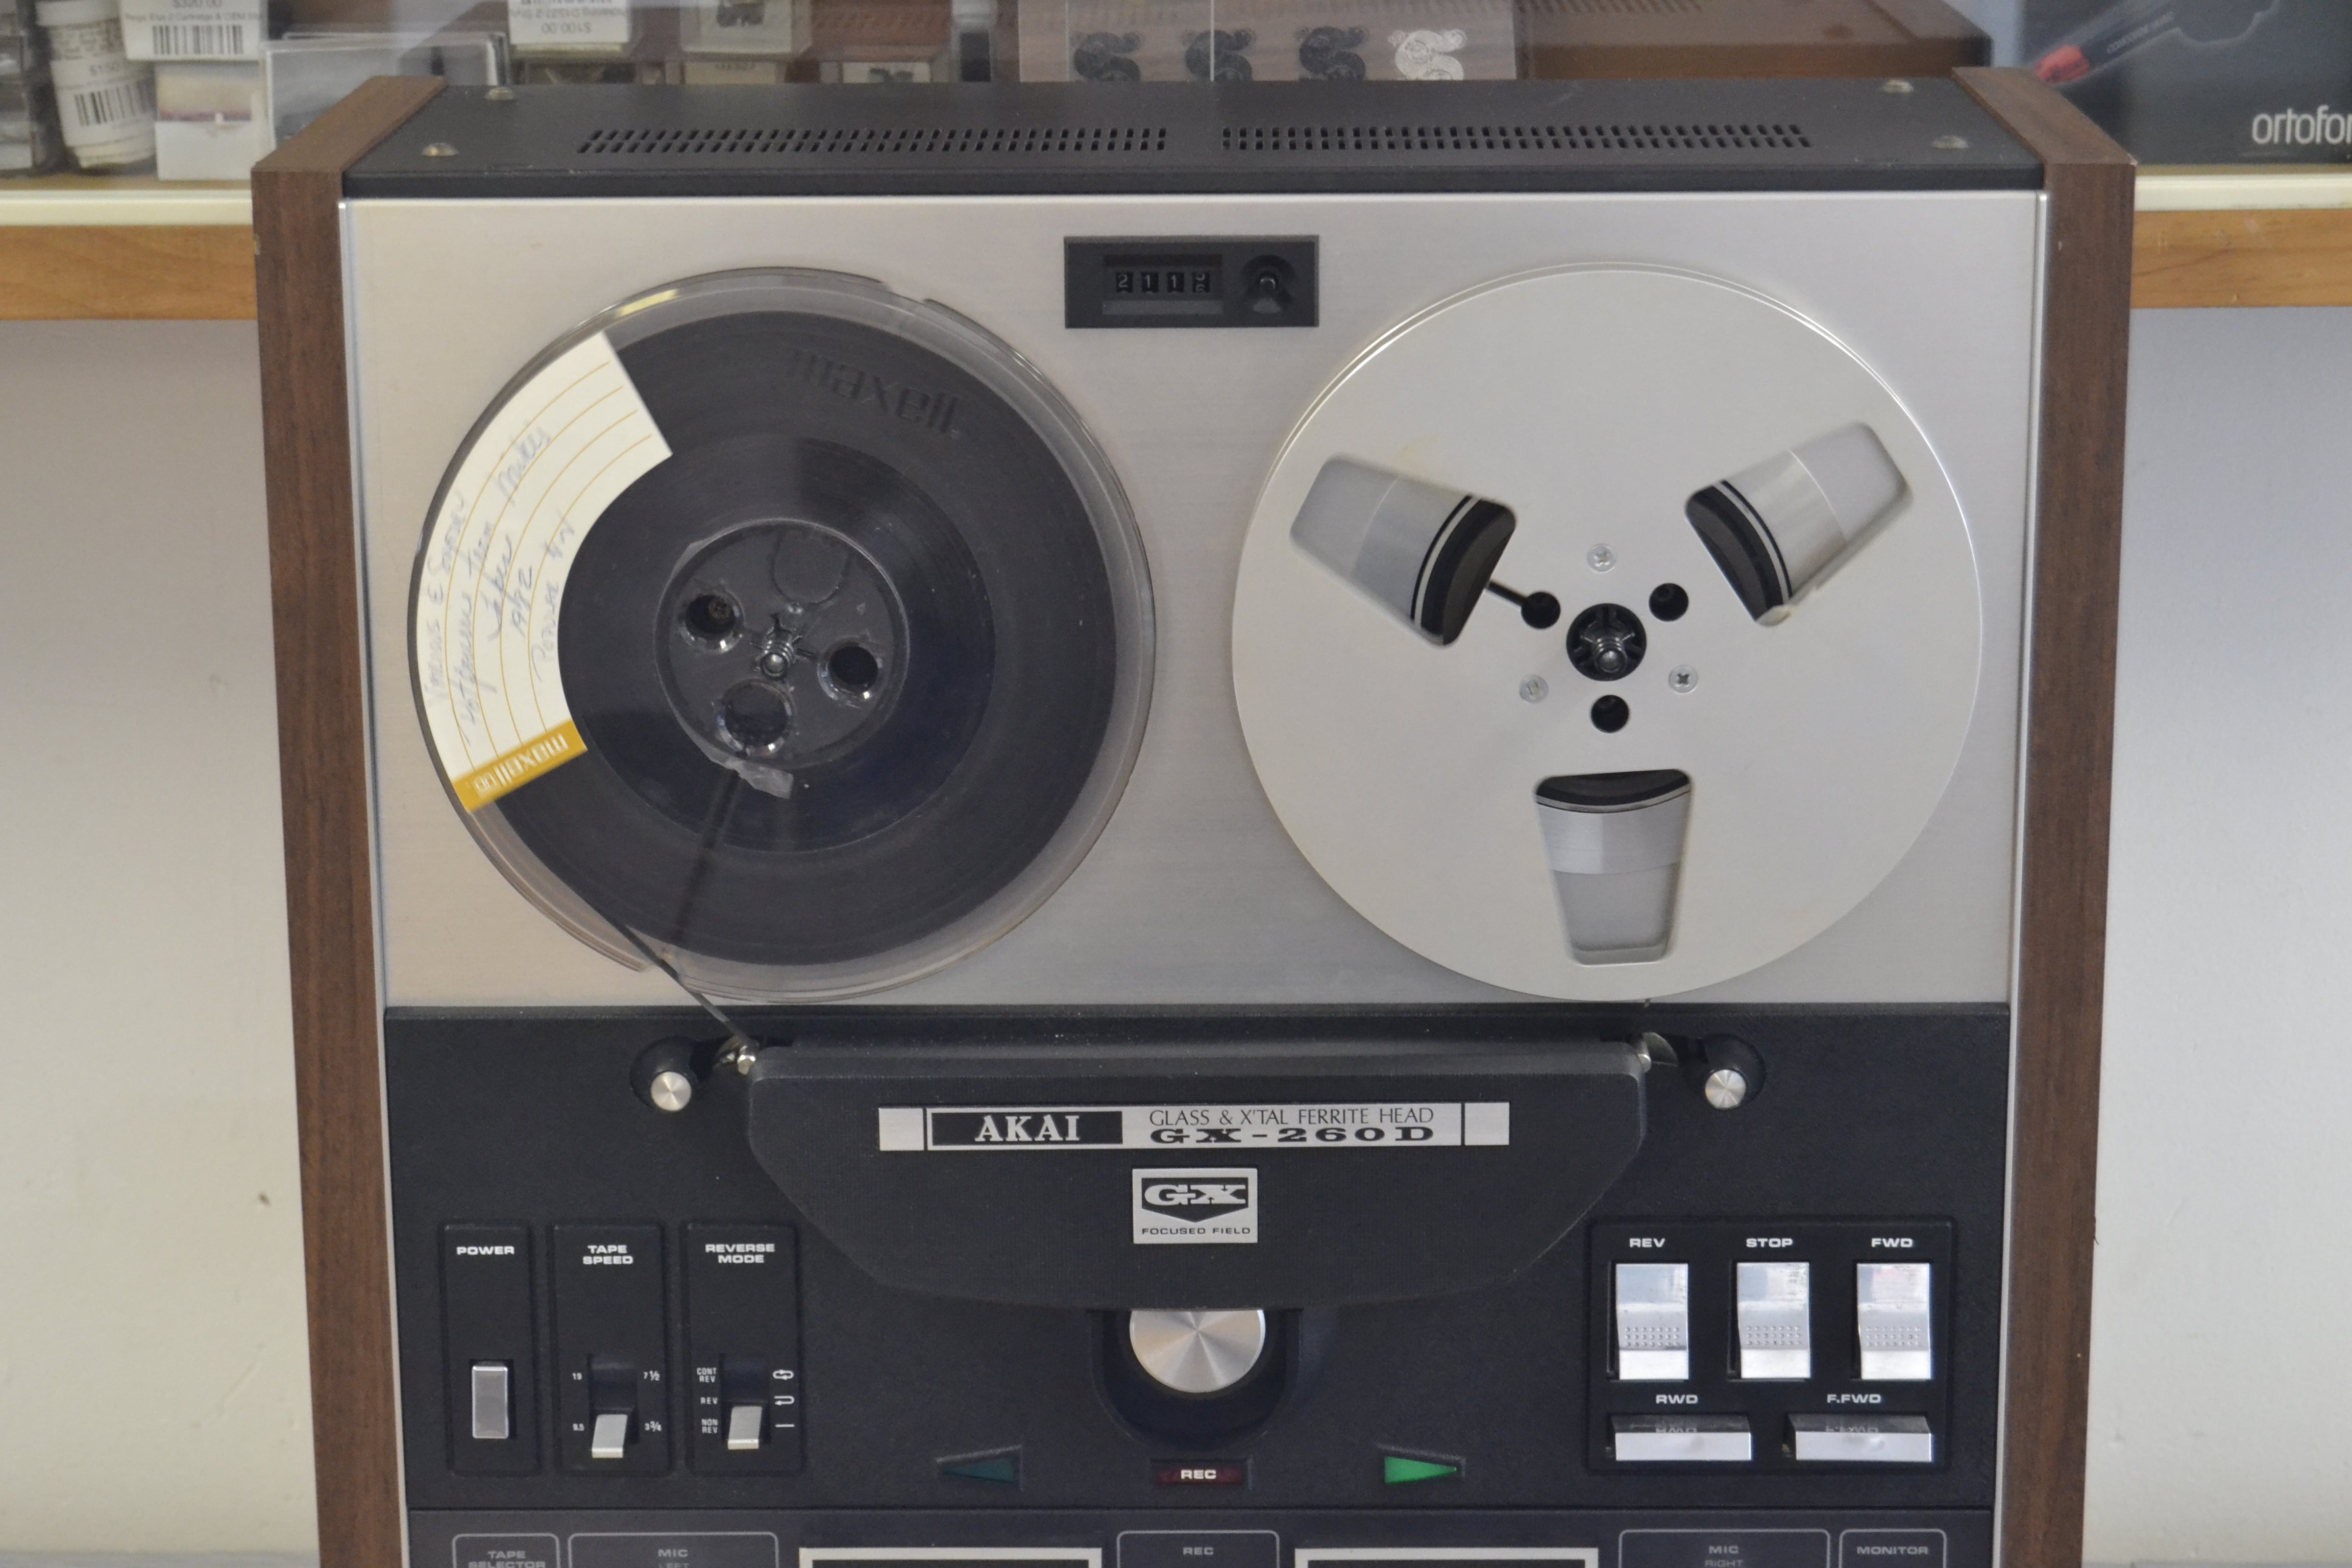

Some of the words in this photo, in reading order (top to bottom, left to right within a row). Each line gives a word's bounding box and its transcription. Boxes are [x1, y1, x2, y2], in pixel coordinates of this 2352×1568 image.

[1149, 1110, 1210, 1126] GLASS
[1219, 1110, 1233, 1125] &
[1240, 1109, 1289, 1125] X'TAL
[1298, 1108, 1369, 1124] FERRITE
[1379, 1108, 1434, 1123] HEAD
[975, 1115, 1080, 1142] AKAI
[1144, 1184, 1246, 1206] GX
[1141, 1227, 1206, 1235] FOCUSED
[1212, 1227, 1251, 1235] FIELD
[1629, 1237, 1666, 1248] REV
[1746, 1237, 1794, 1248] STOP
[1871, 1237, 1914, 1248] FWD
[456, 1245, 515, 1256] POWER
[587, 1244, 628, 1254] TAPE
[704, 1243, 776, 1253] REVERSE
[582, 1255, 634, 1265] SPEED
[717, 1254, 765, 1264] MODE
[696, 1366, 717, 1376] CONT
[698, 1375, 716, 1383] REV
[700, 1396, 719, 1405] REV
[1655, 1393, 1699, 1405] RWD
[1826, 1393, 1882, 1404] F.FWD
[701, 1418, 719, 1427] NON
[701, 1426, 718, 1434] REV
[1180, 1469, 1217, 1480] REC
[487, 1550, 526, 1559] TAPE
[657, 1548, 689, 1558] MIC
[1182, 1546, 1214, 1556] REC
[1708, 1545, 1739, 1555] MIC
[1856, 1546, 1929, 1556] MONITOR
[1704, 1558, 1744, 1568] RIGHT
